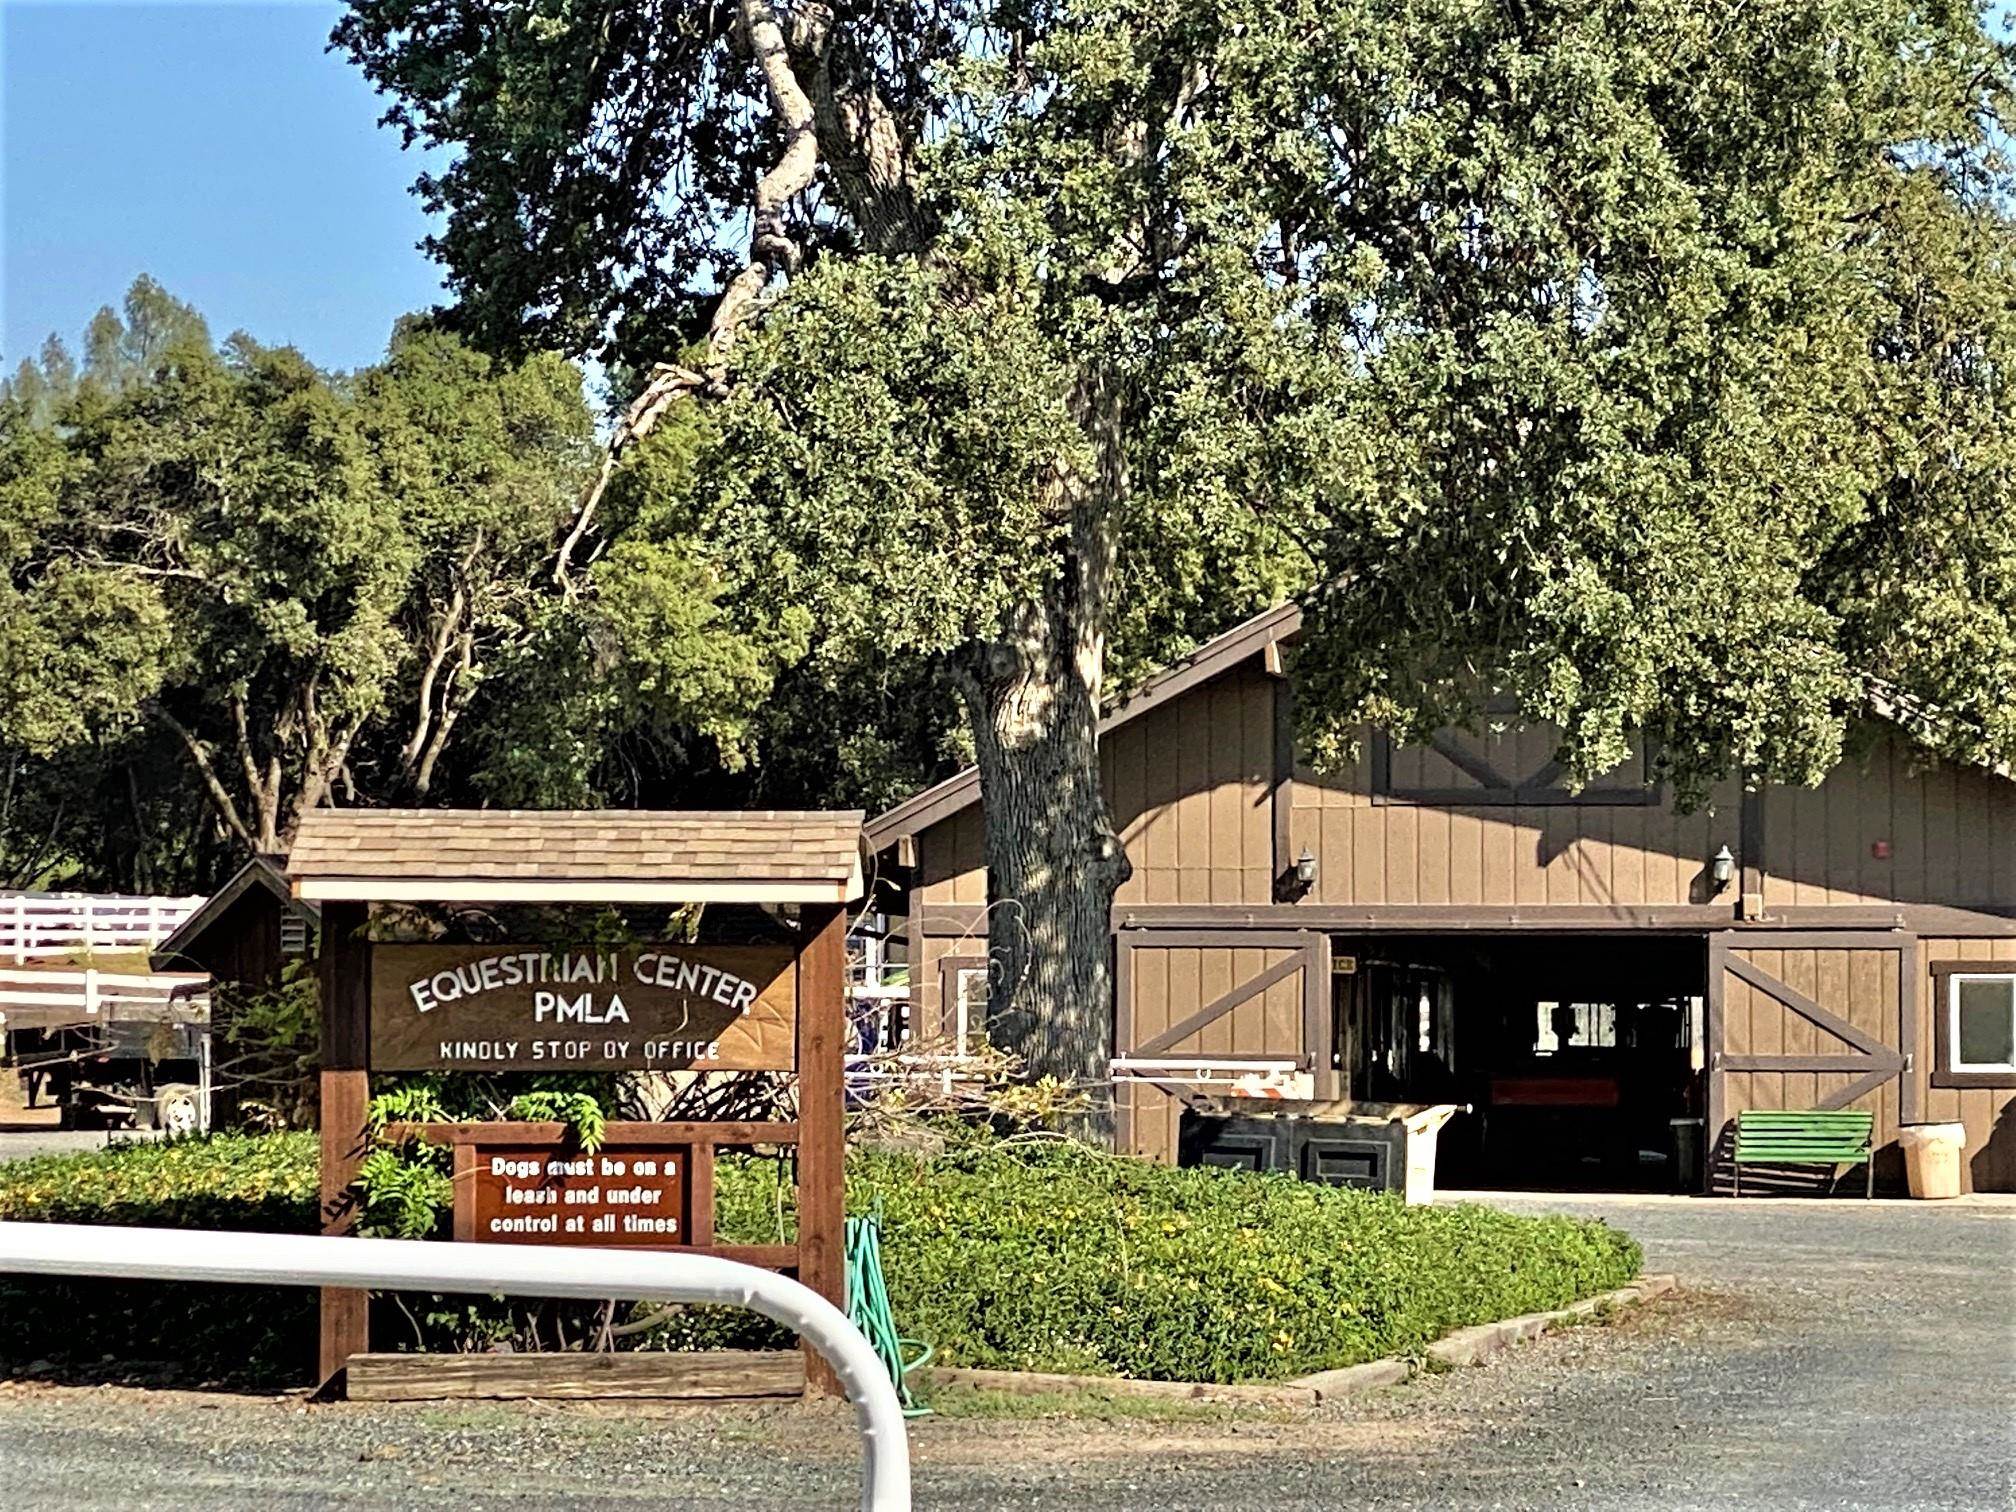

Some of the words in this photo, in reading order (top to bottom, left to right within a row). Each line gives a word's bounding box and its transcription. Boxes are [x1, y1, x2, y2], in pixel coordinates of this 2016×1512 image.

[633, 953, 758, 1016] CENTER
[534, 992, 630, 1024] PMLA
[440, 1041, 518, 1060] KINDLY
[532, 1041, 592, 1060] STOP
[644, 1041, 721, 1060] OFFICE
[491, 1157, 540, 1178] Dogs
[547, 1158, 595, 1176] must
[601, 1158, 626, 1176] be
[633, 1160, 657, 1176] on
[664, 1160, 676, 1176] a
[505, 1185, 558, 1204] leash
[564, 1185, 600, 1205] and
[606, 1185, 663, 1205] under
[490, 1213, 558, 1233] control
[564, 1214, 585, 1233] at
[592, 1213, 616, 1233] all
[623, 1213, 677, 1233] times
